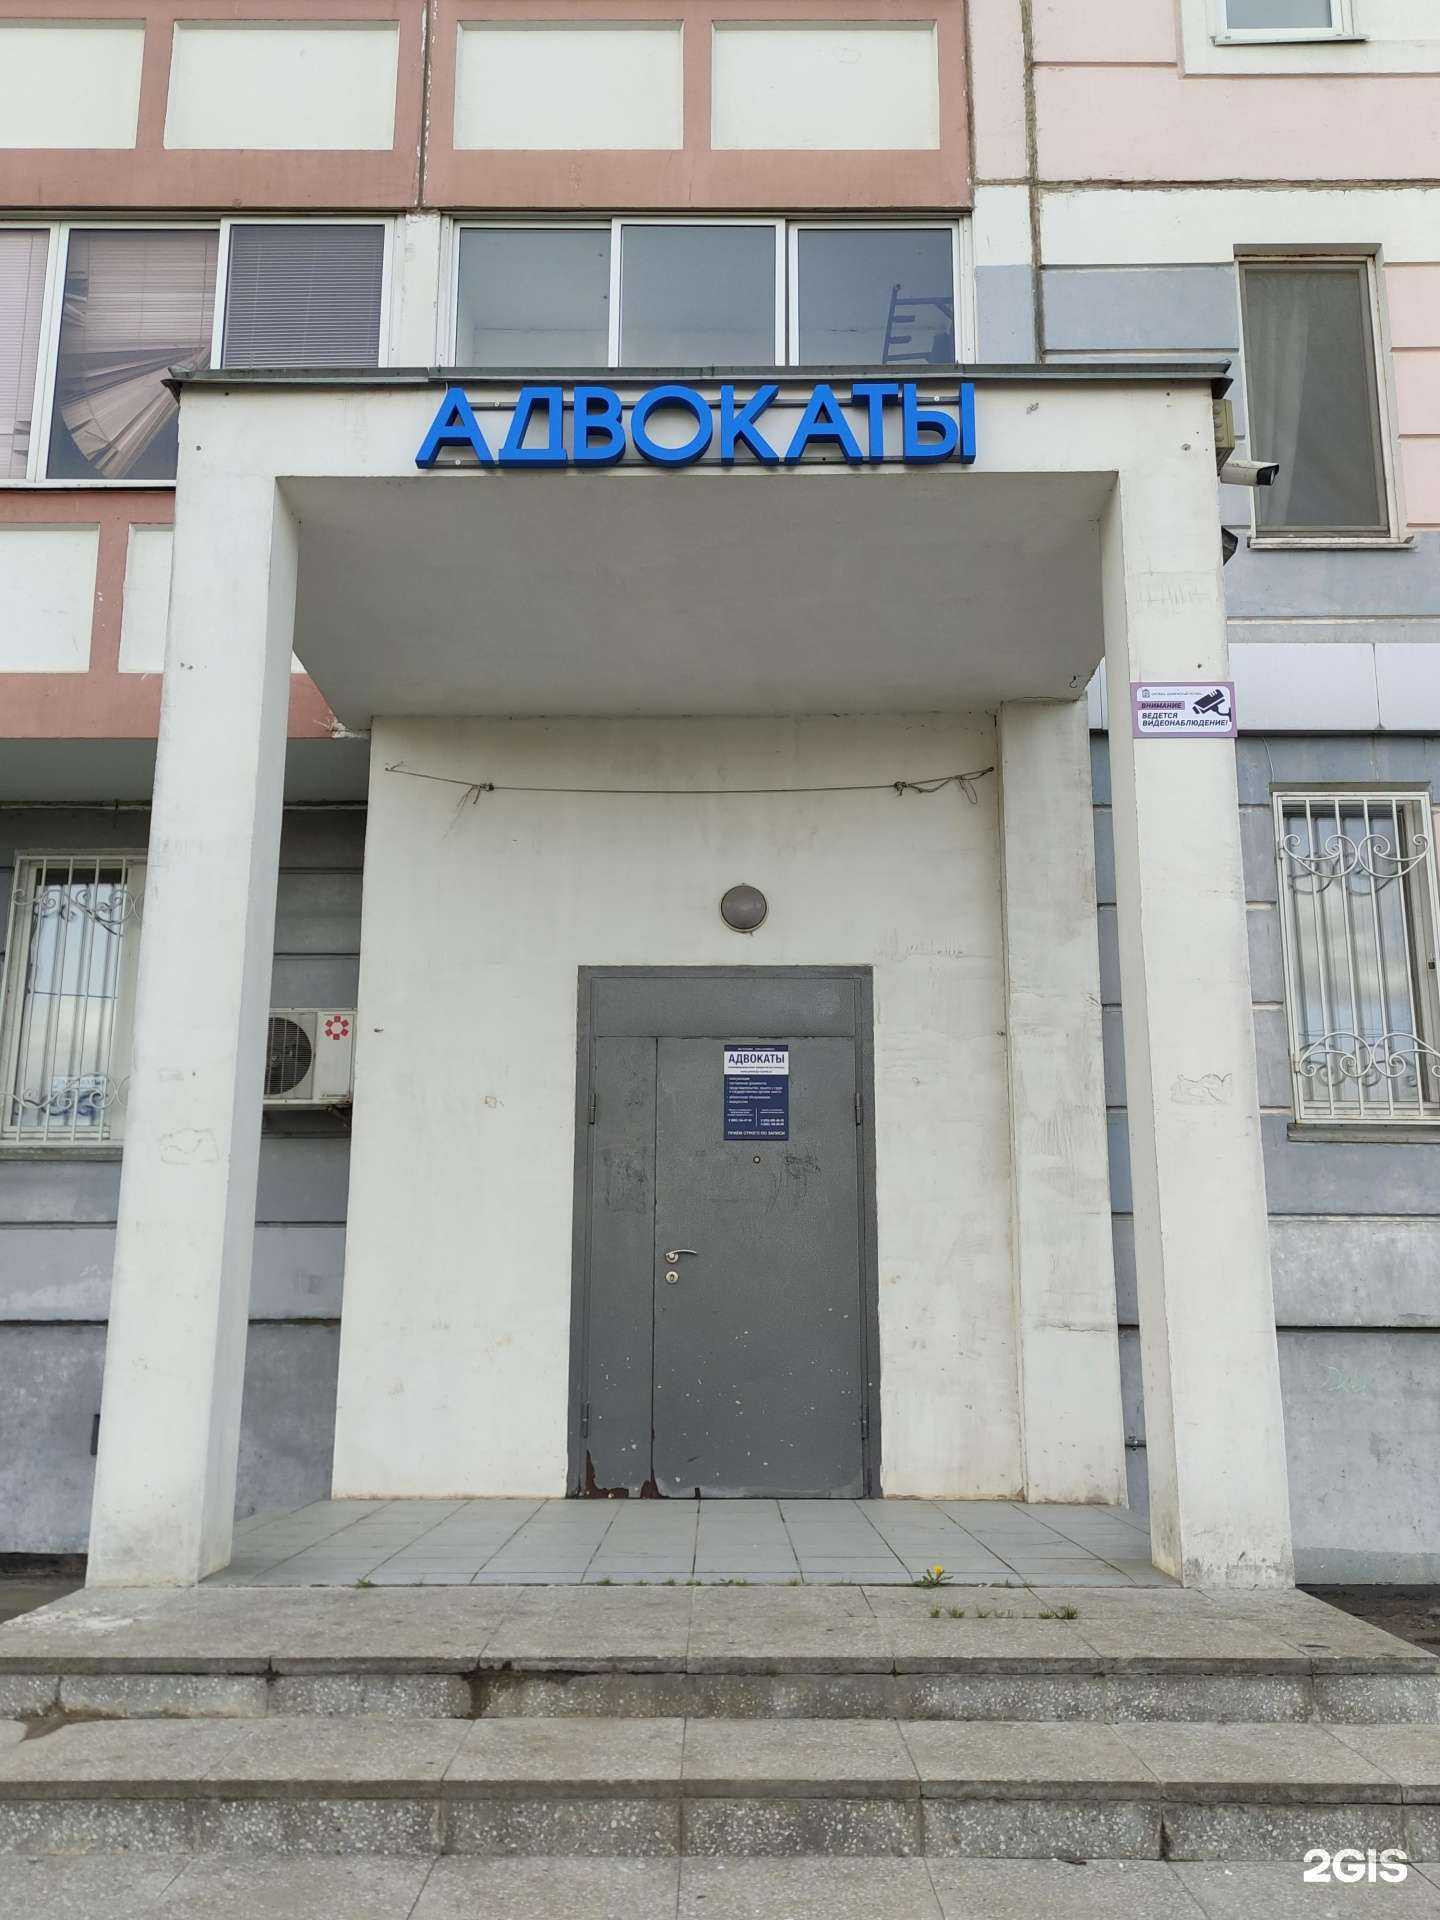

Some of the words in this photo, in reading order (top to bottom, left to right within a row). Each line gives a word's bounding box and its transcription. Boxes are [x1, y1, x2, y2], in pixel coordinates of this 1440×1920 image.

[415, 383, 976, 468] АДВОКАТЫ
[1142, 719, 1228, 727] ВИДЕОНАБЛЮДЕНИЕ!
[728, 1053, 785, 1065] АДВОКАТЫ
